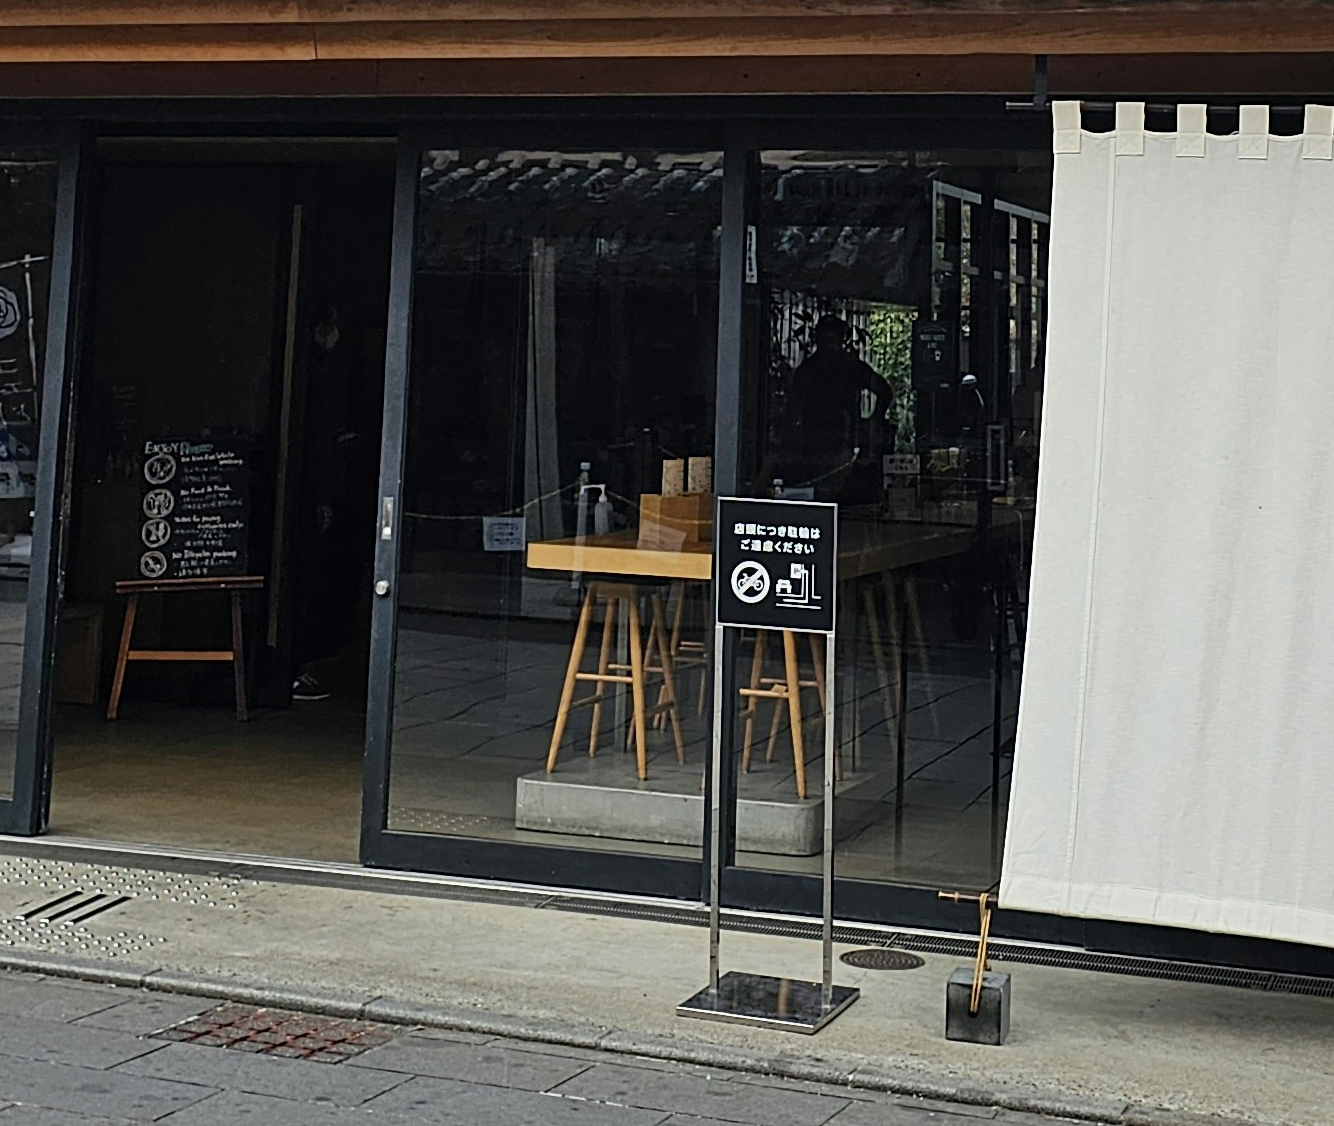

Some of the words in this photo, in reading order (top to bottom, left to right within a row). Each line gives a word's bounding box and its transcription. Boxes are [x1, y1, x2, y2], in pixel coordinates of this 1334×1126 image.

[740, 539, 815, 554] ご遠慮ください
